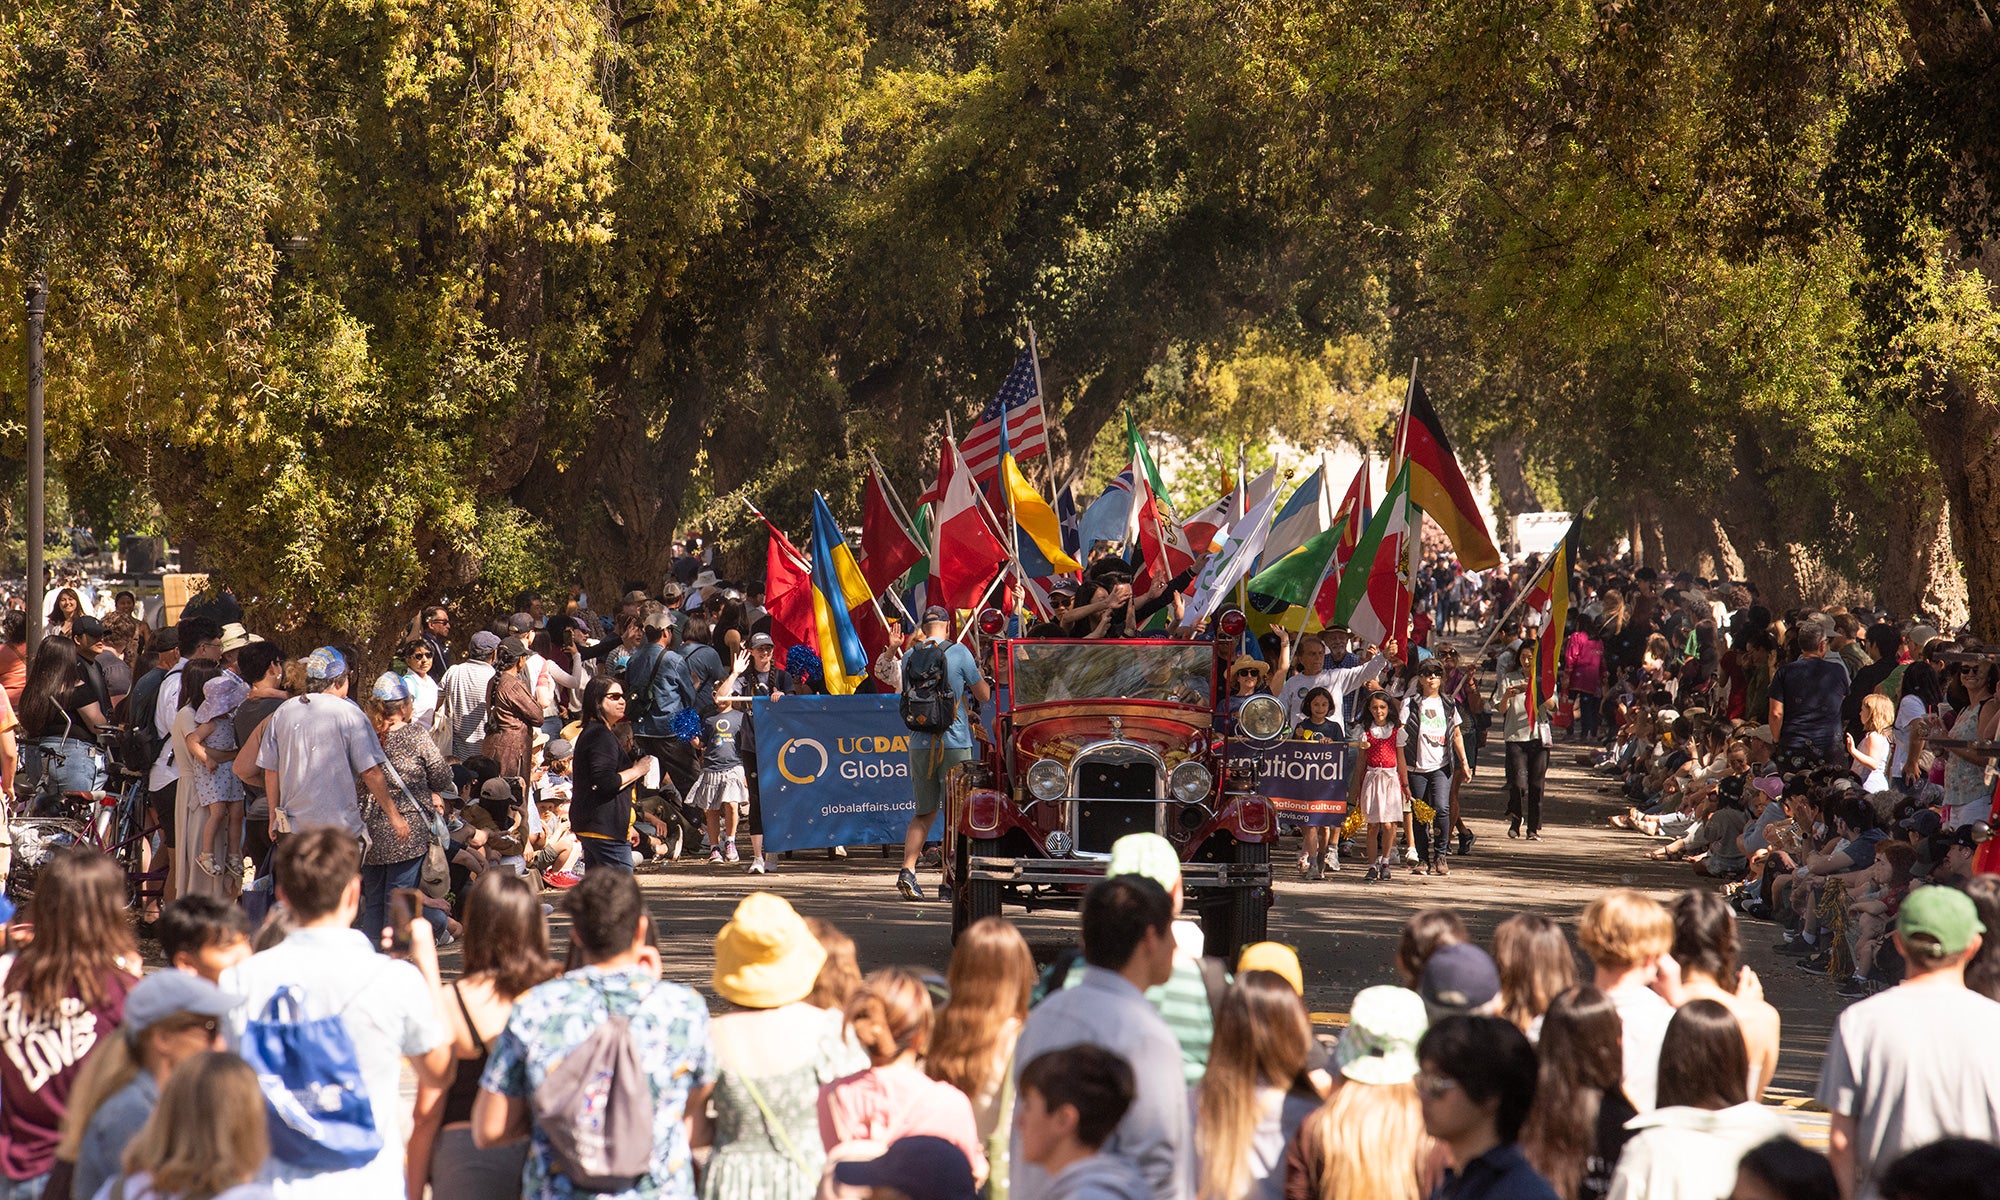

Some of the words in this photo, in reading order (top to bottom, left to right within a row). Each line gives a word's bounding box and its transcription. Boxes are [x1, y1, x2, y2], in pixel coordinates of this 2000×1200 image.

[1294, 751, 1333, 760] DAVIS
[840, 759, 908, 779] Globa
[1310, 802, 1342, 811] culture
